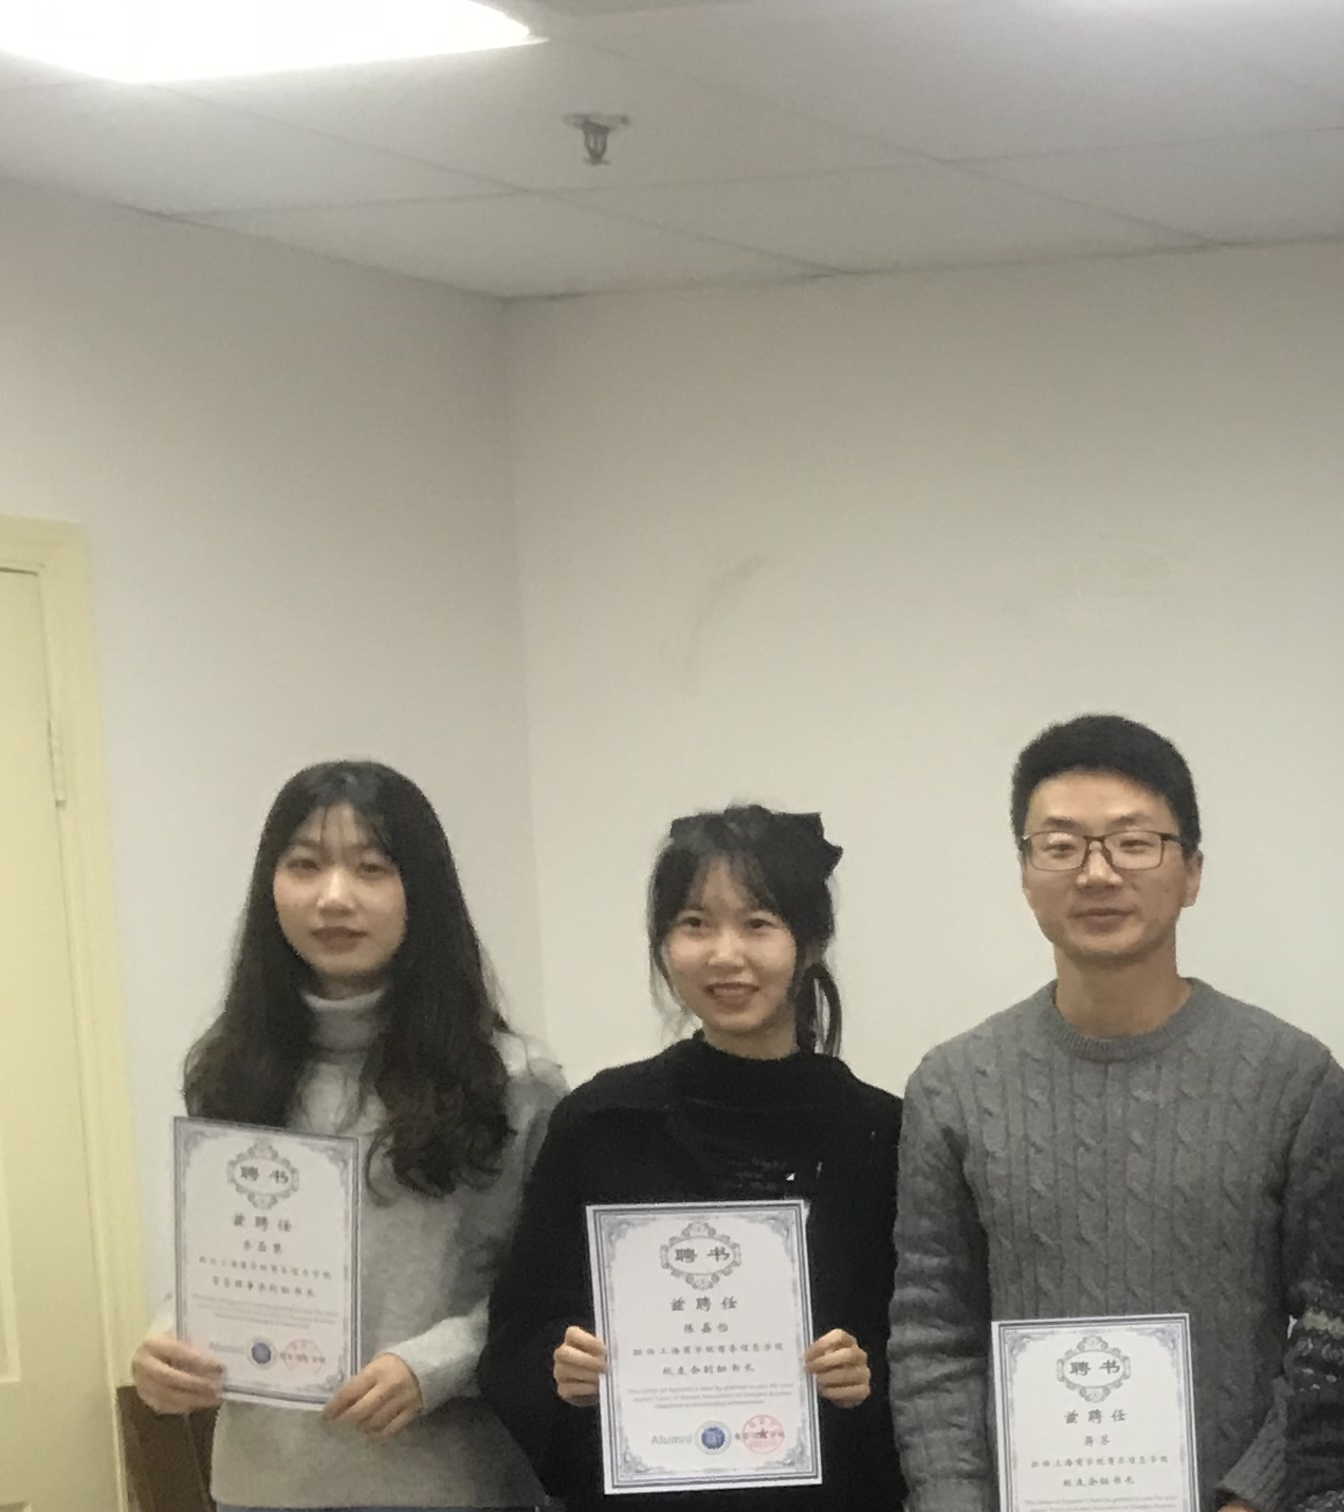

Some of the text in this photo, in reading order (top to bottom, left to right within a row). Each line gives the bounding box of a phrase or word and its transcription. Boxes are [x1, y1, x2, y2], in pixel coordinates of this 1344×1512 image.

[675, 1246, 730, 1263] 聘书
[670, 1296, 737, 1312] 兹聘任
[1069, 1359, 1120, 1376] 聘书
[1064, 1408, 1126, 1425] 兹聘任
